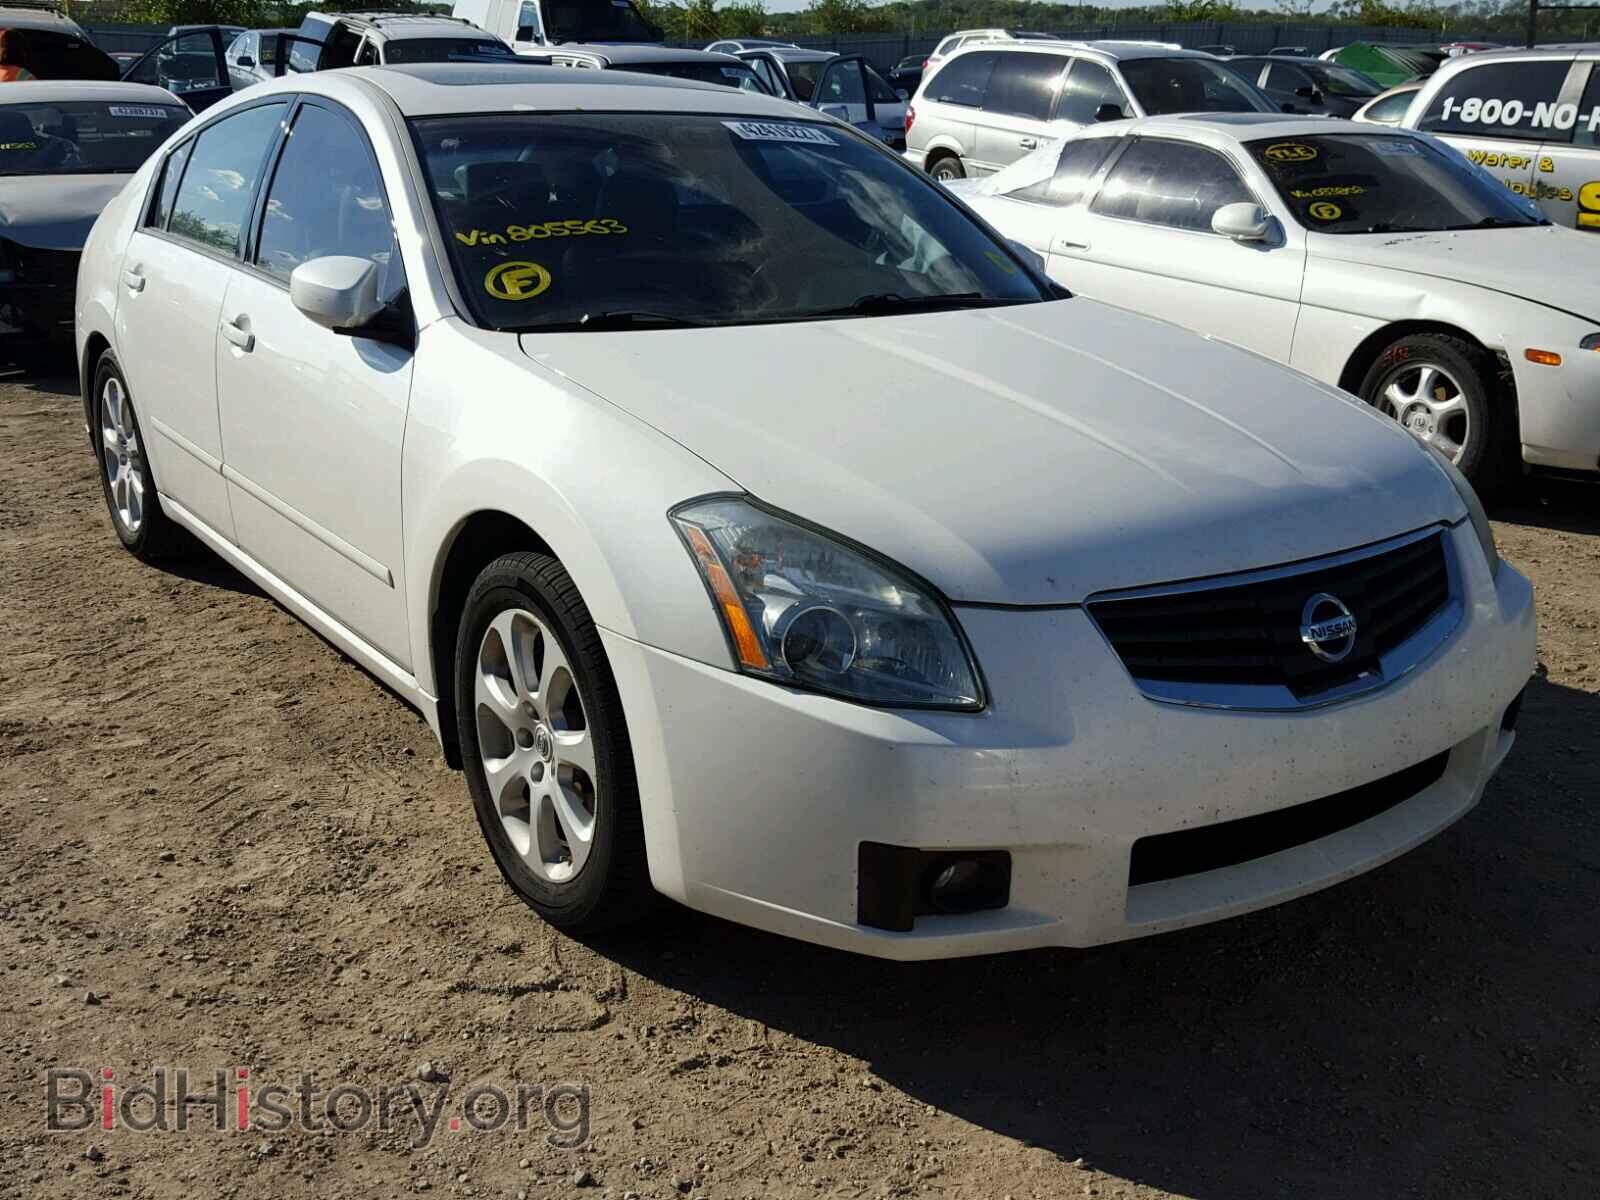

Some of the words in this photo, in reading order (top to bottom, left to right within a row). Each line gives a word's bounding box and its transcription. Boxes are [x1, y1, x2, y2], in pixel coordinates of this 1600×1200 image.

[1467, 150, 1530, 169] Water
[1539, 157, 1554, 172] &
[456, 230, 507, 246] Vin
[507, 219, 627, 240] 805563
[501, 269, 535, 295] F
[1311, 620, 1354, 638] NISSAN
